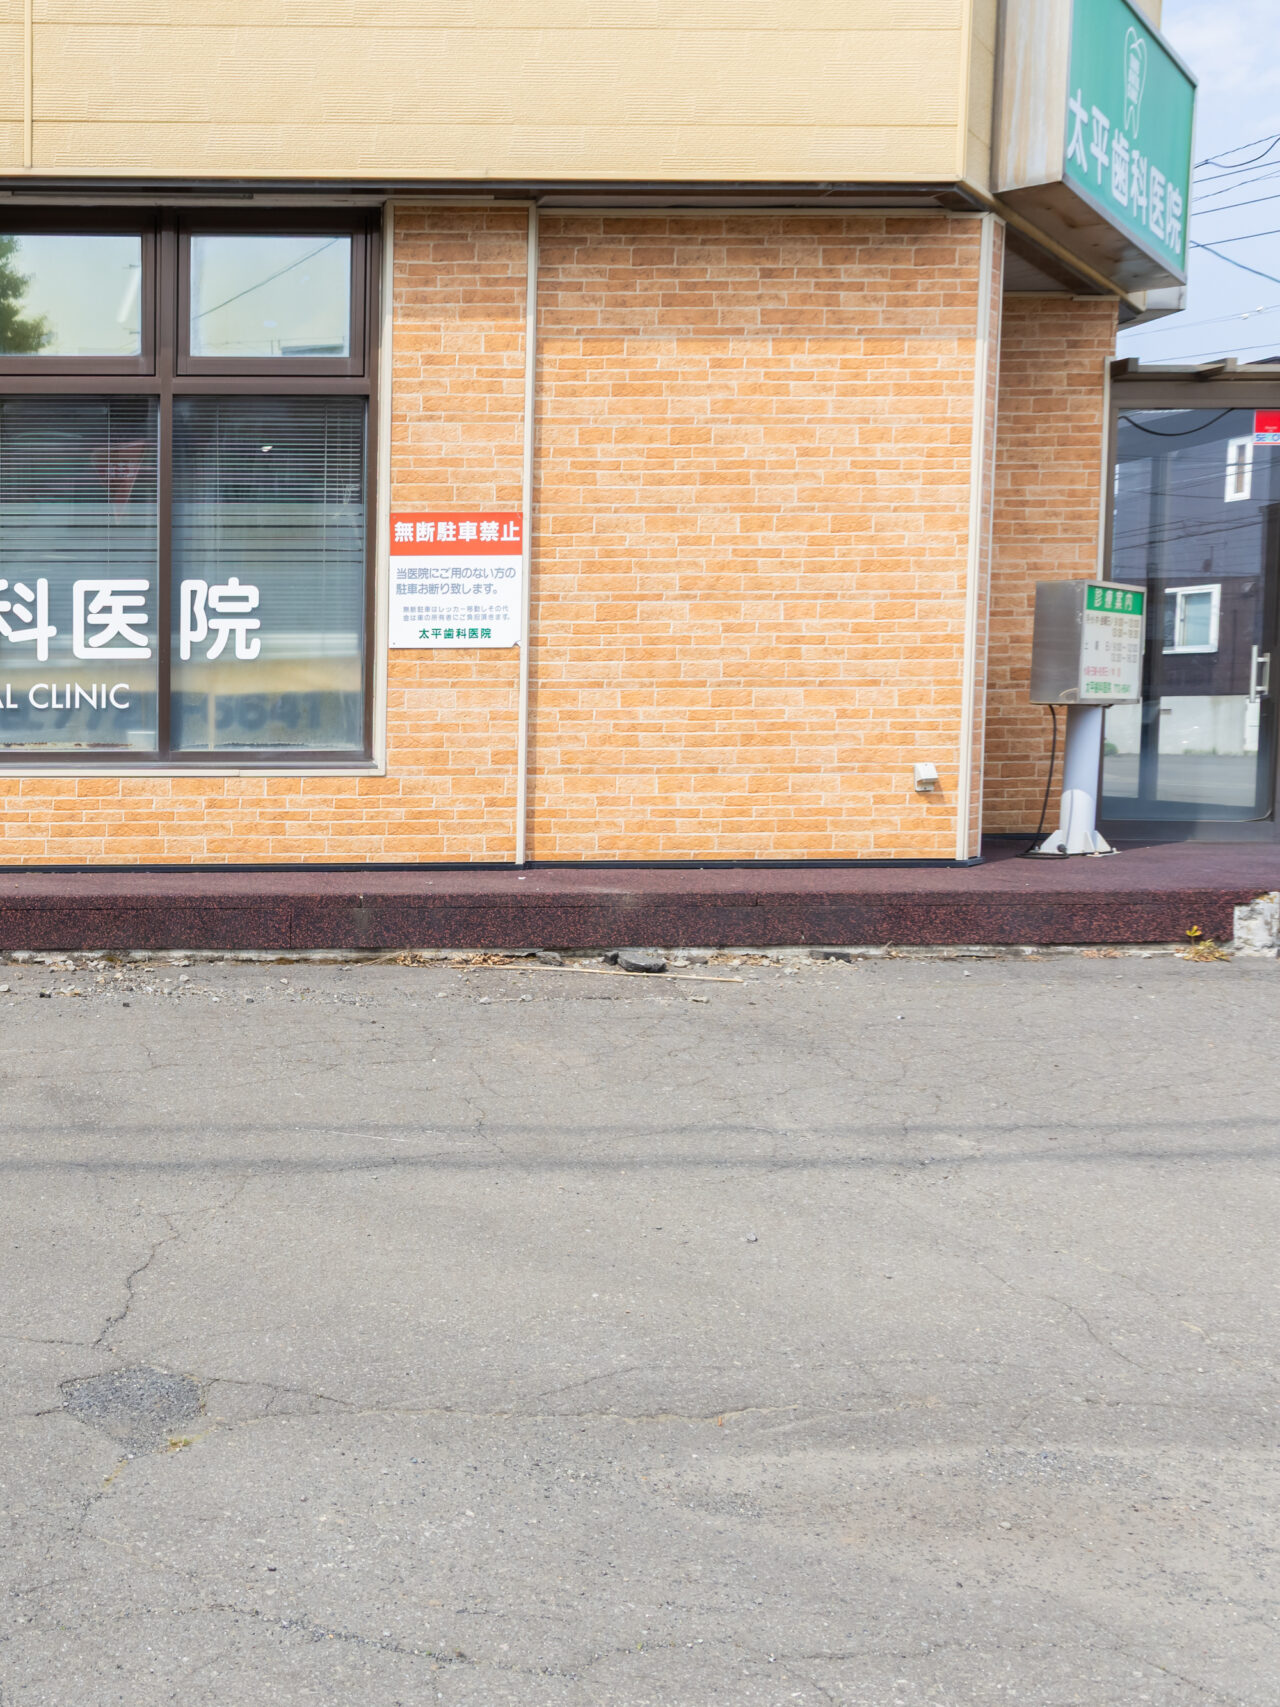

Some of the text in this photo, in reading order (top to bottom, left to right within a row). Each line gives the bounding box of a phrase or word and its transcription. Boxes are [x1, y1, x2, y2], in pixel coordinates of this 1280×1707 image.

[1066, 88, 1183, 255] 太平歯科医院
[394, 520, 521, 543] 無断駐車禁止
[396, 567, 516, 579] 当医院にご用のない方の
[395, 583, 498, 595] 駐車お断り致します。
[418, 628, 492, 639] 太平歯科医院
[28, 682, 130, 710] CLINIC
